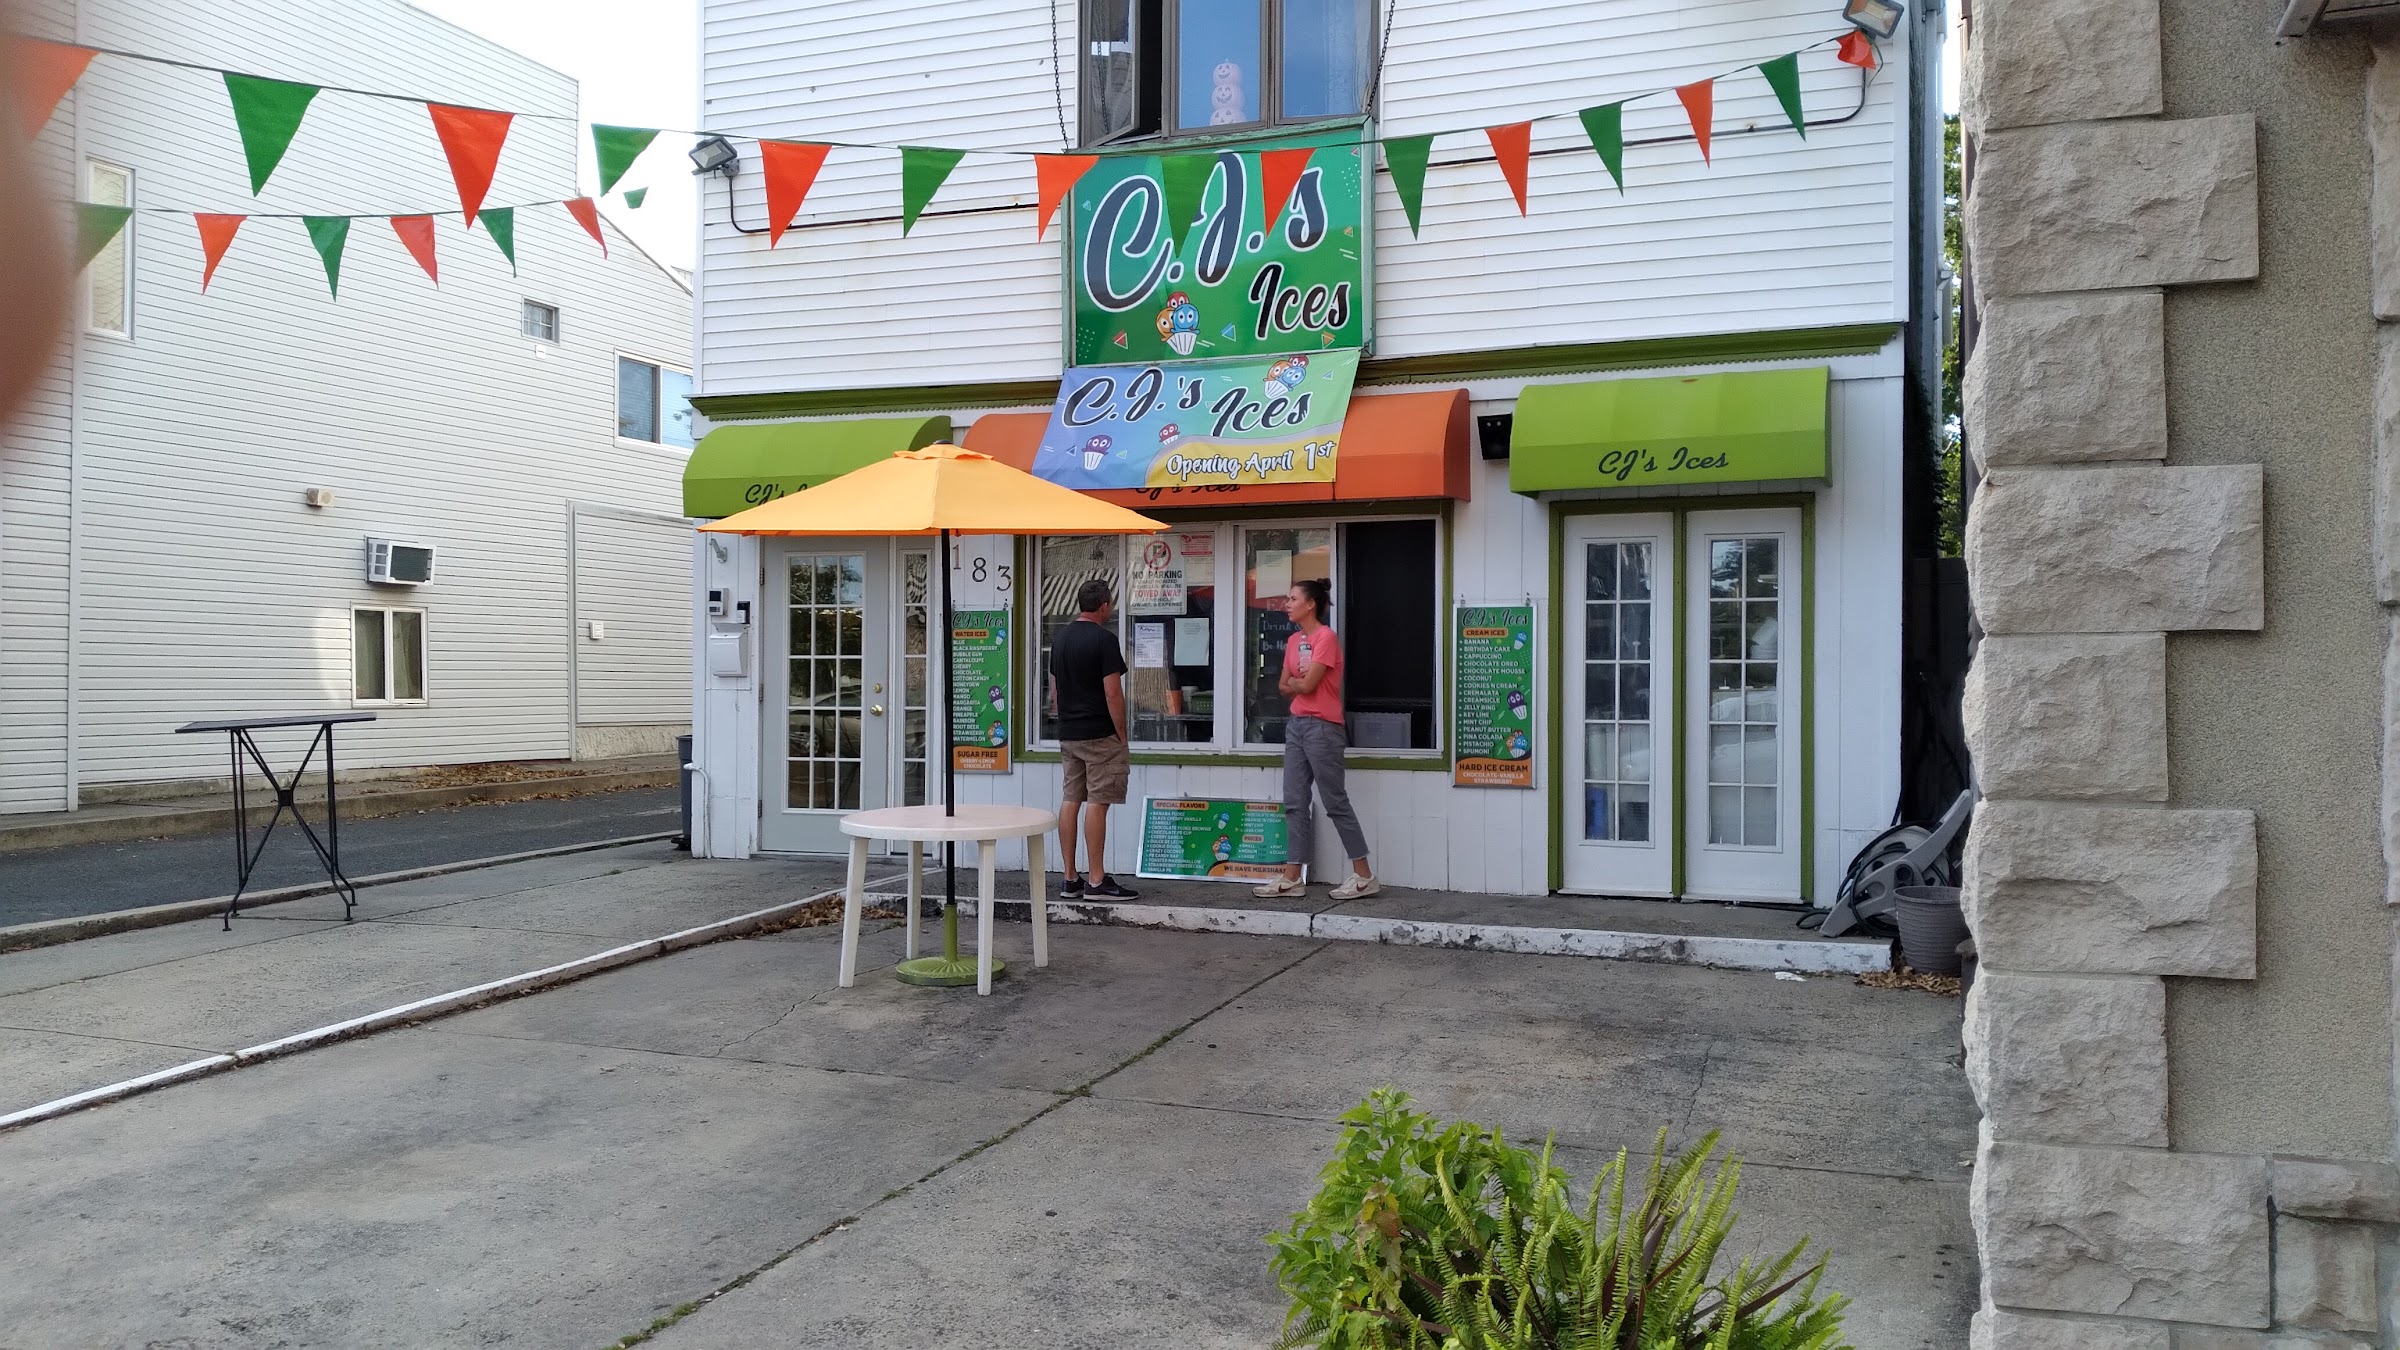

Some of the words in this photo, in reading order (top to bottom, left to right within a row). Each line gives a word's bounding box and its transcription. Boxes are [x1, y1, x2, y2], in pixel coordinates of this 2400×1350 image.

[1084, 149, 1329, 312] C.J.s
[1249, 261, 1351, 341] Ices
[1062, 366, 1205, 428] C.J.'s
[1210, 387, 1312, 438] Ices
[1166, 449, 1242, 483] Opening
[1244, 450, 1293, 479] April
[1304, 441, 1335, 471] 1st
[1598, 448, 1658, 481] CJ's
[1668, 446, 1729, 471] Ices
[952, 545, 1012, 591] 183
[1133, 571, 1143, 579] NO
[1149, 570, 1182, 578] PARKING
[1163, 589, 1181, 597] AWAY
[983, 613, 1005, 628] Ices
[1501, 609, 1528, 627] Ices
